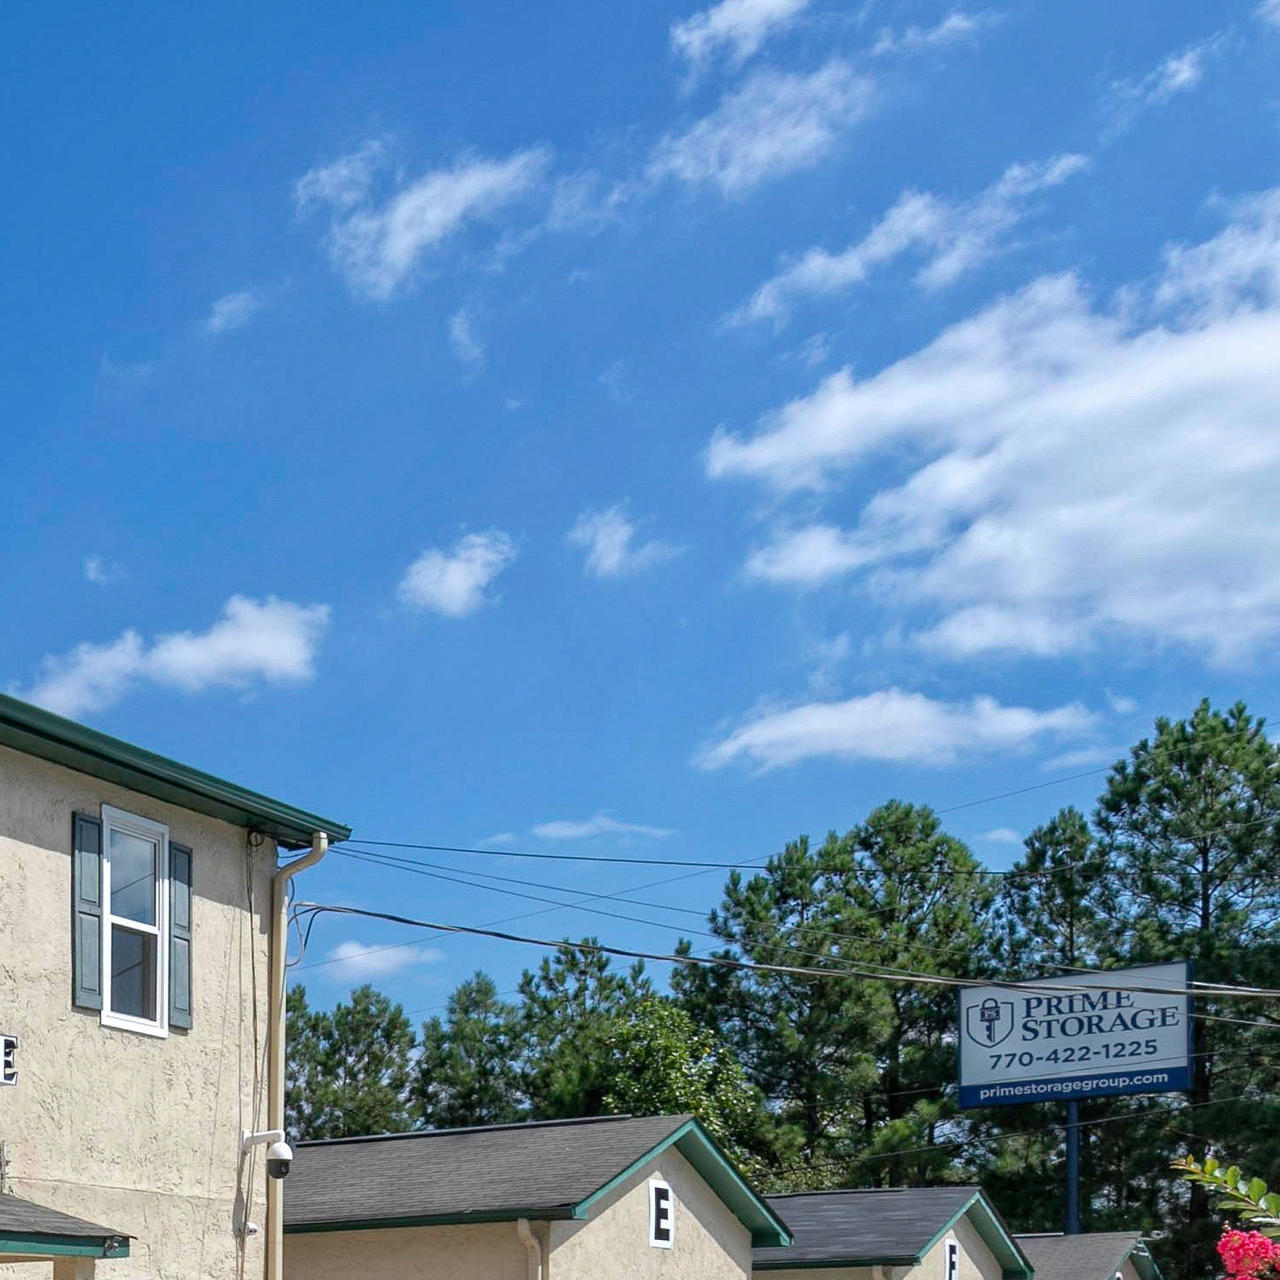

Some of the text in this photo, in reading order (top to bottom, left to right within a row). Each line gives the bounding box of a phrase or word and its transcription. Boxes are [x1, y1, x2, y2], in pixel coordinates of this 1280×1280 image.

[1022, 990, 1135, 1019] PRIME
[1021, 1006, 1181, 1042] STORAGE
[989, 1039, 1158, 1070] 770-422-1225
[979, 1071, 1169, 1100] primestoragegroup.com
[654, 1186, 670, 1241] E
